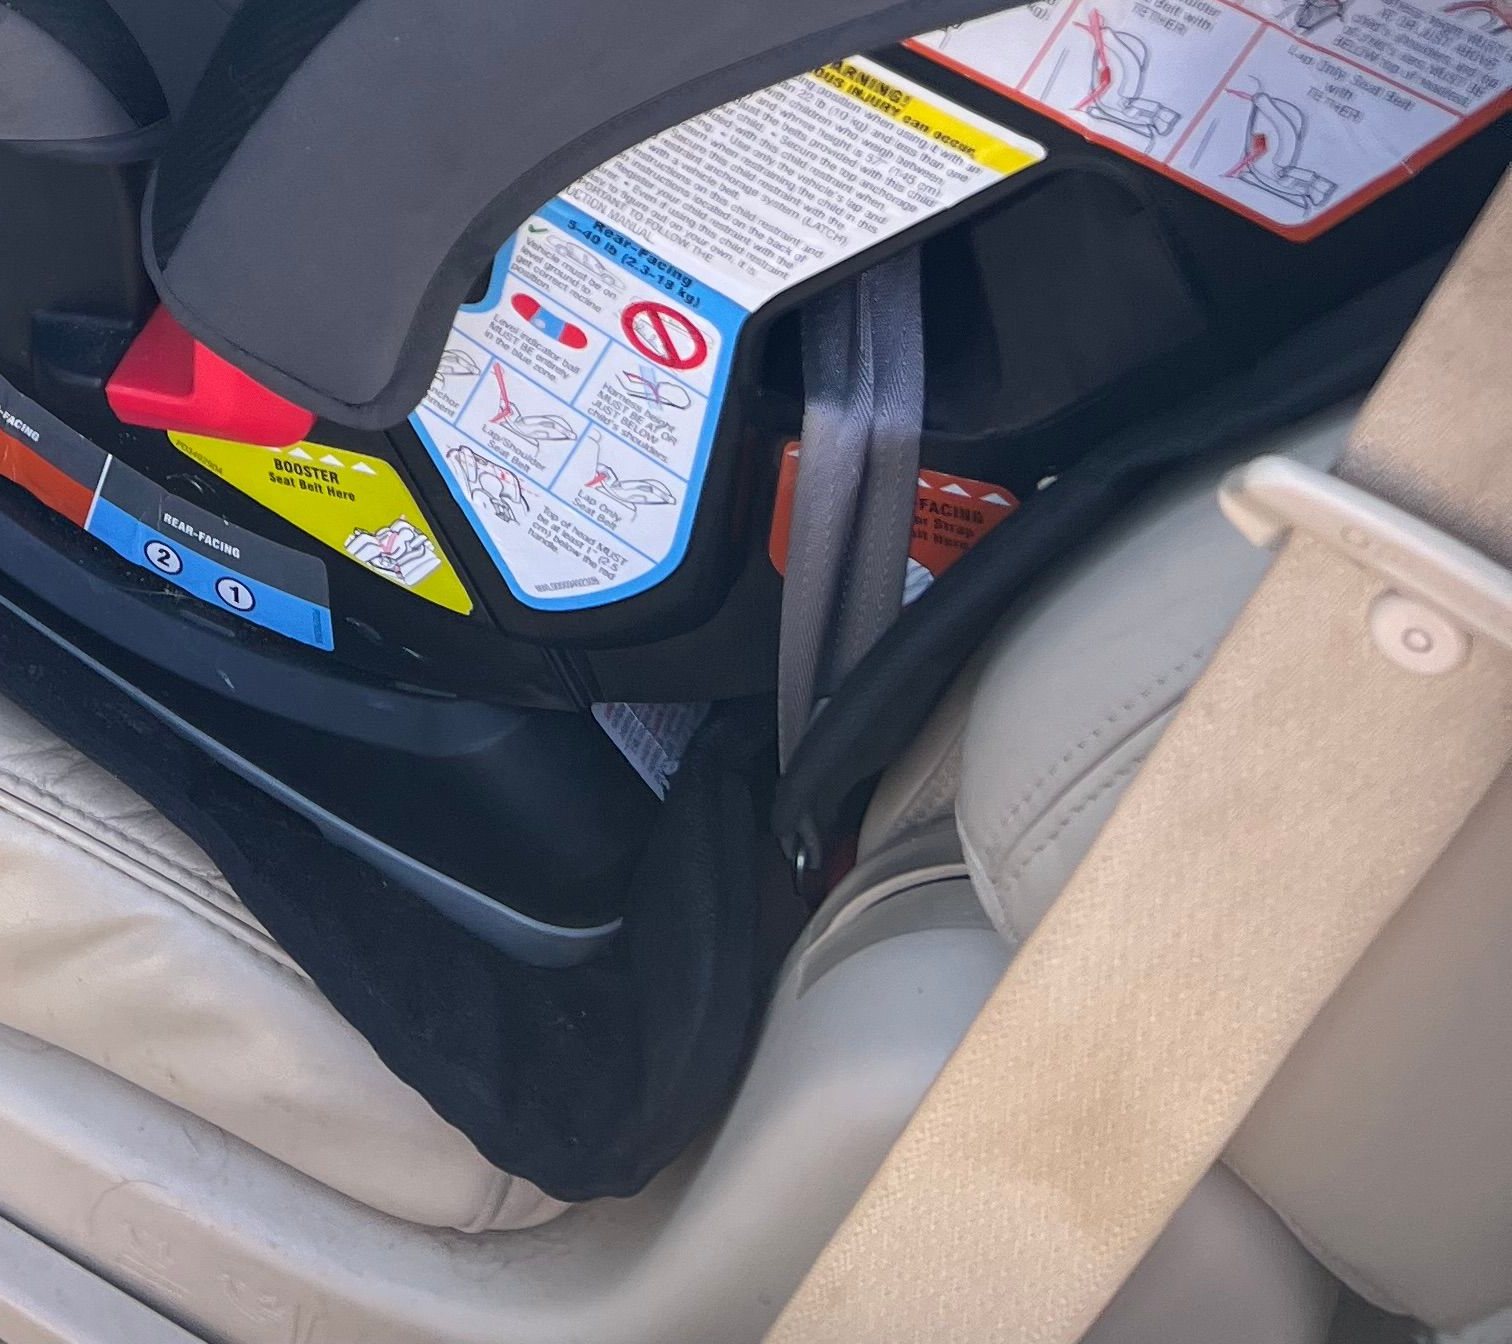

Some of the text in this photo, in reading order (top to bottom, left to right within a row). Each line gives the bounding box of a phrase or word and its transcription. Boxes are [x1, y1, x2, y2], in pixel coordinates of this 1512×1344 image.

[832, 60, 910, 107] ARNING!
[813, 66, 846, 88] OUS
[901, 114, 930, 133] can
[592, 220, 694, 288] Rear-Facing
[519, 342, 533, 355] BE
[429, 385, 460, 408] nchor
[628, 410, 644, 424] BE
[486, 439, 531, 473] Seat Belt
[273, 458, 340, 485] BOOSTER
[268, 472, 356, 502] Seat Belt Here
[919, 498, 985, 525] FACING
[163, 513, 241, 560] REAR-FACING
[157, 548, 171, 567] 2
[230, 586, 240, 603] 1
